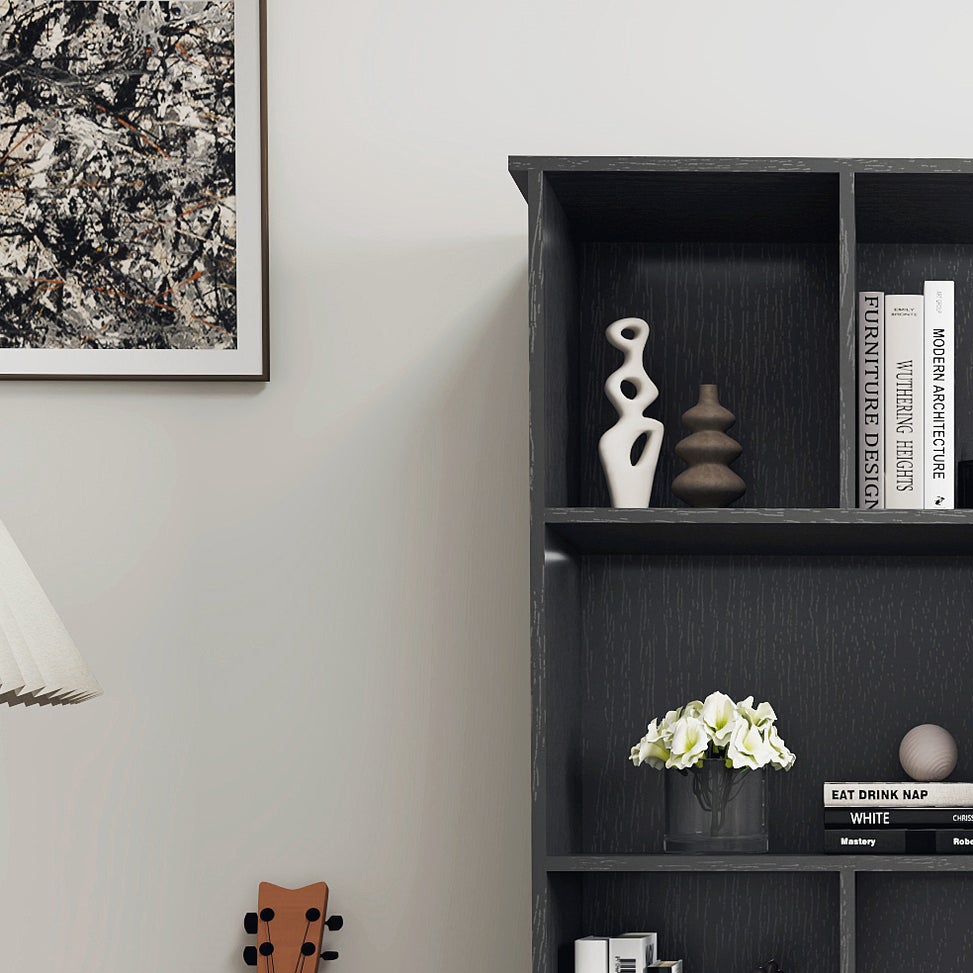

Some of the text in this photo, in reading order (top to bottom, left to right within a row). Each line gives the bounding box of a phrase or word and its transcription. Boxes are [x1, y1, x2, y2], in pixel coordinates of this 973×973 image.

[864, 295, 879, 425] FURNITURE
[895, 360, 914, 492] WUTHERING HEIGHTS
[932, 328, 946, 480] MODERN ARCHITECTURE
[831, 789, 929, 801] EAT DRINK NAP
[850, 812, 890, 825] WHITE
[840, 837, 876, 848] Mastery
